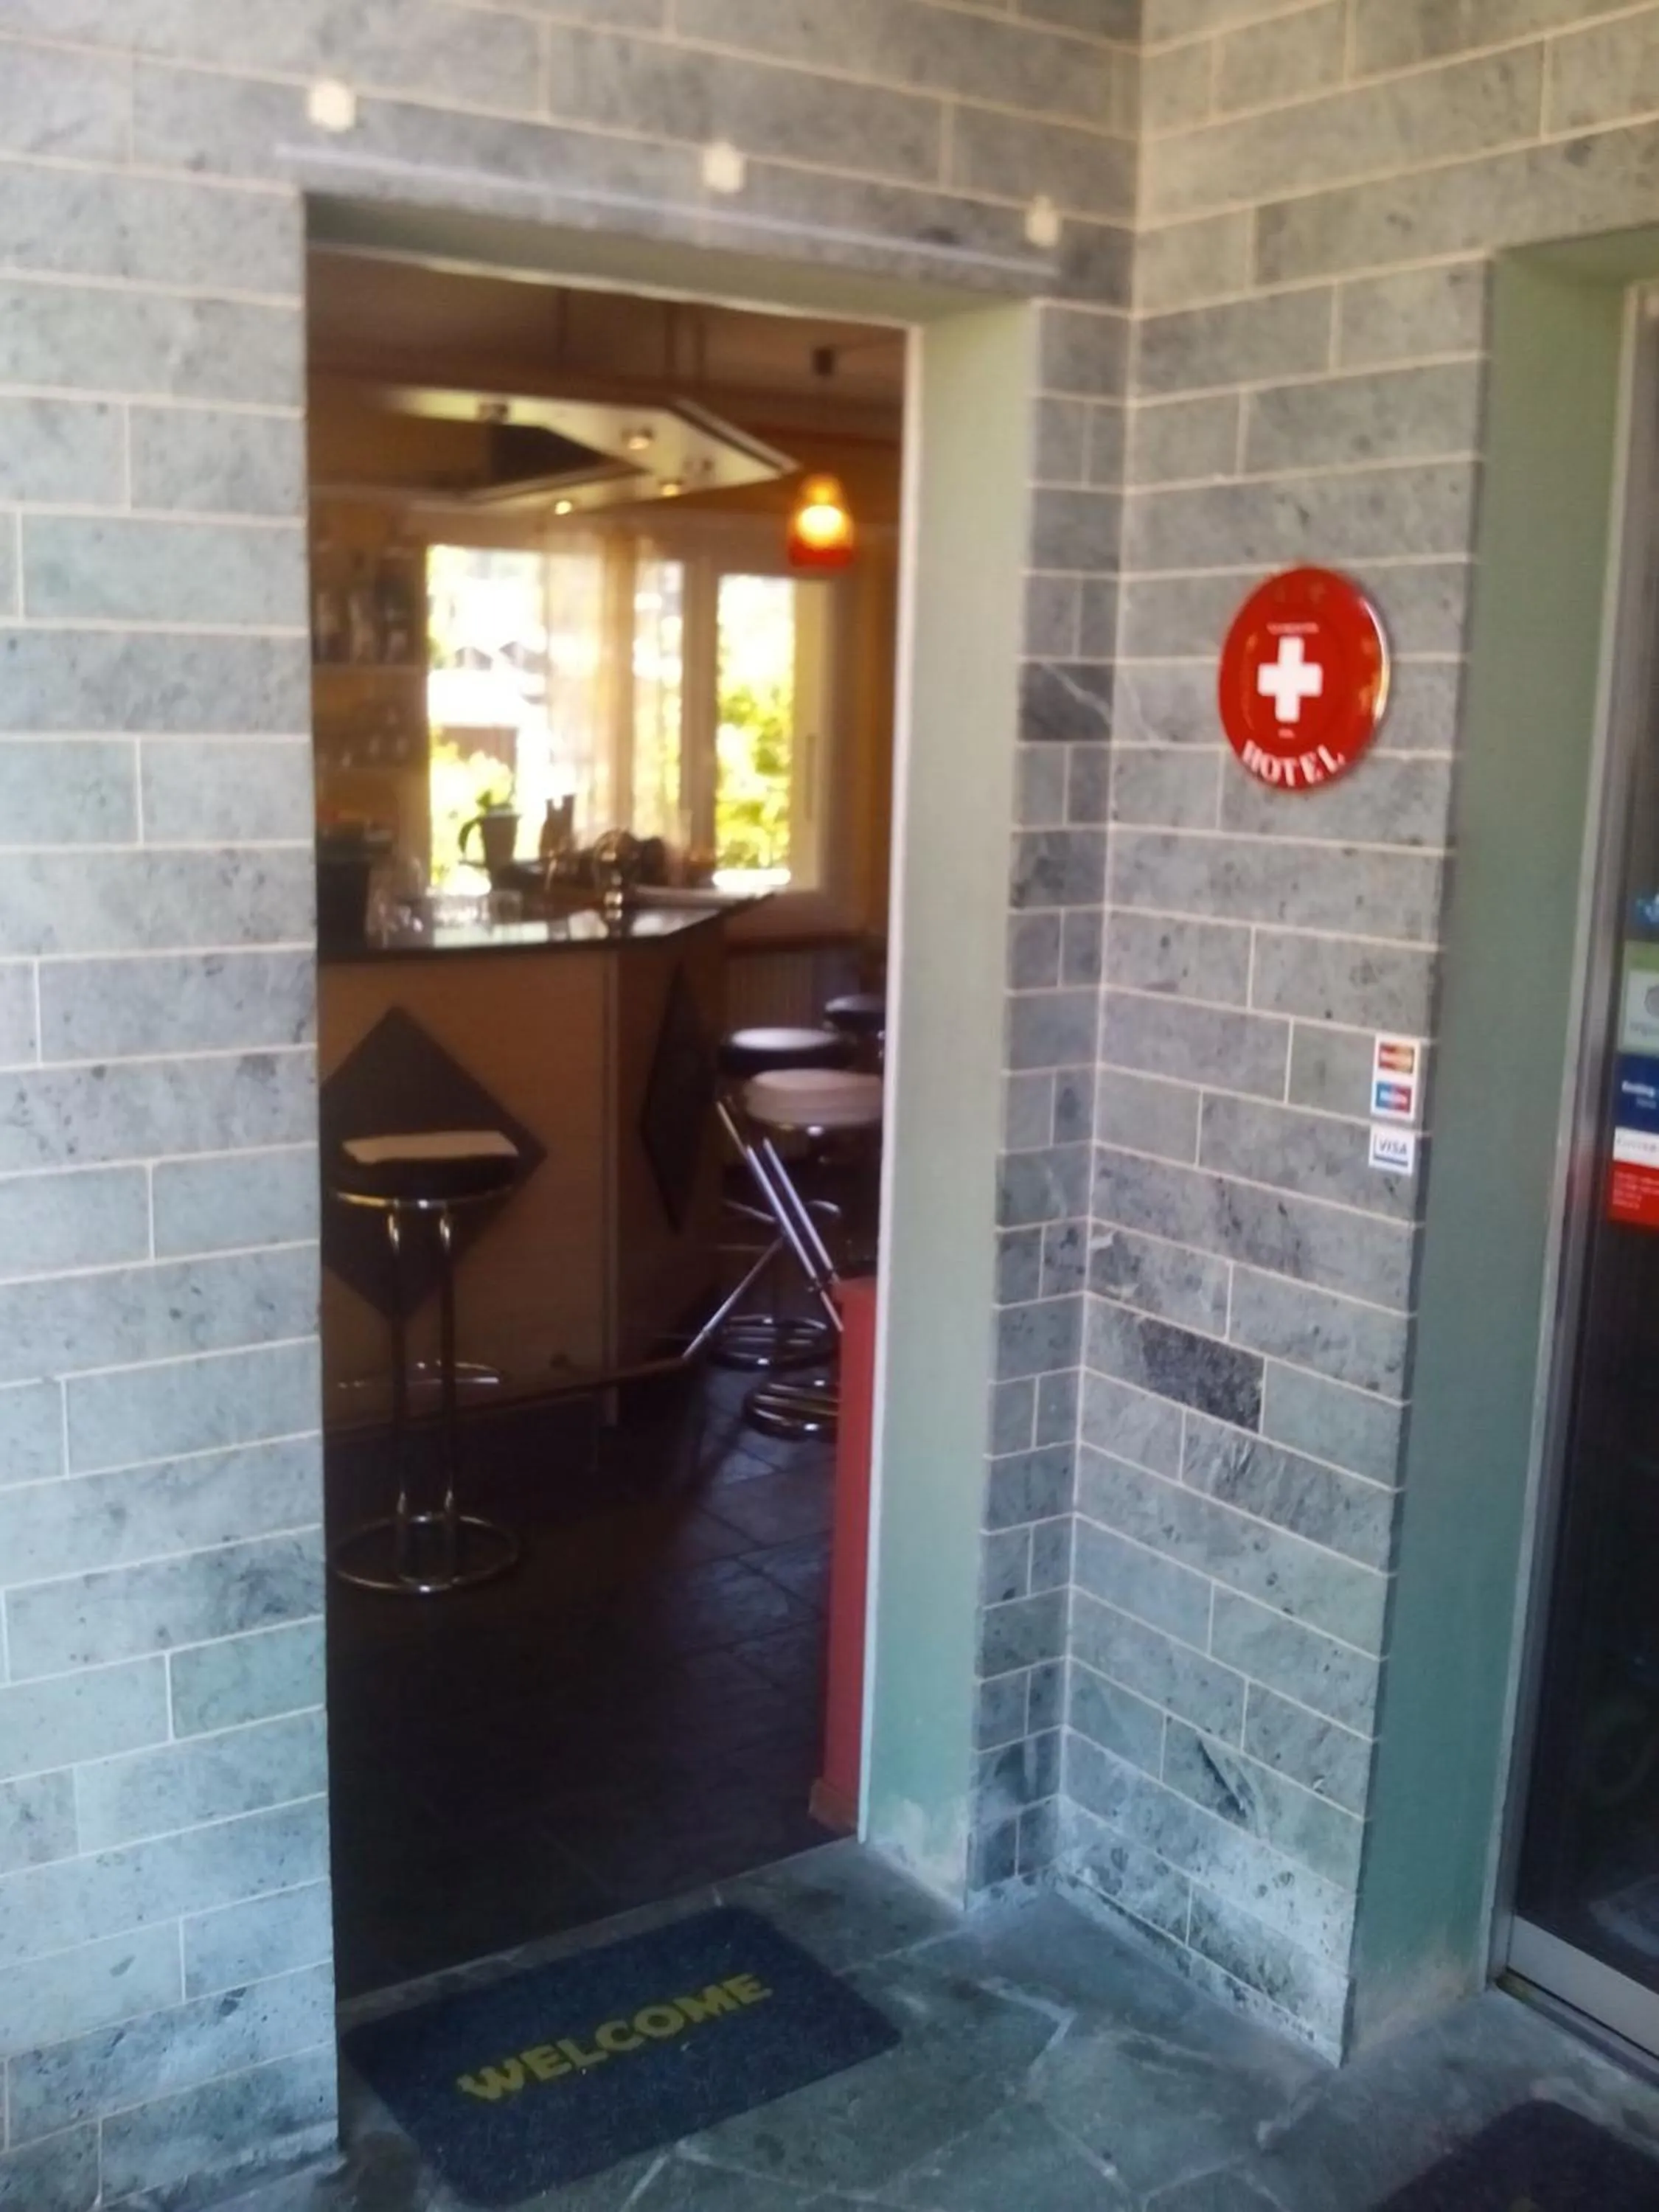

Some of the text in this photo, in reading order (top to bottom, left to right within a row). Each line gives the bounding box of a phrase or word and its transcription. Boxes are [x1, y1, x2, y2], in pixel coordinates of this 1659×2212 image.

[1242, 740, 1346, 787] HOTEL
[1379, 1138, 1408, 1156] VISA
[456, 1973, 773, 2101] WELCOME
